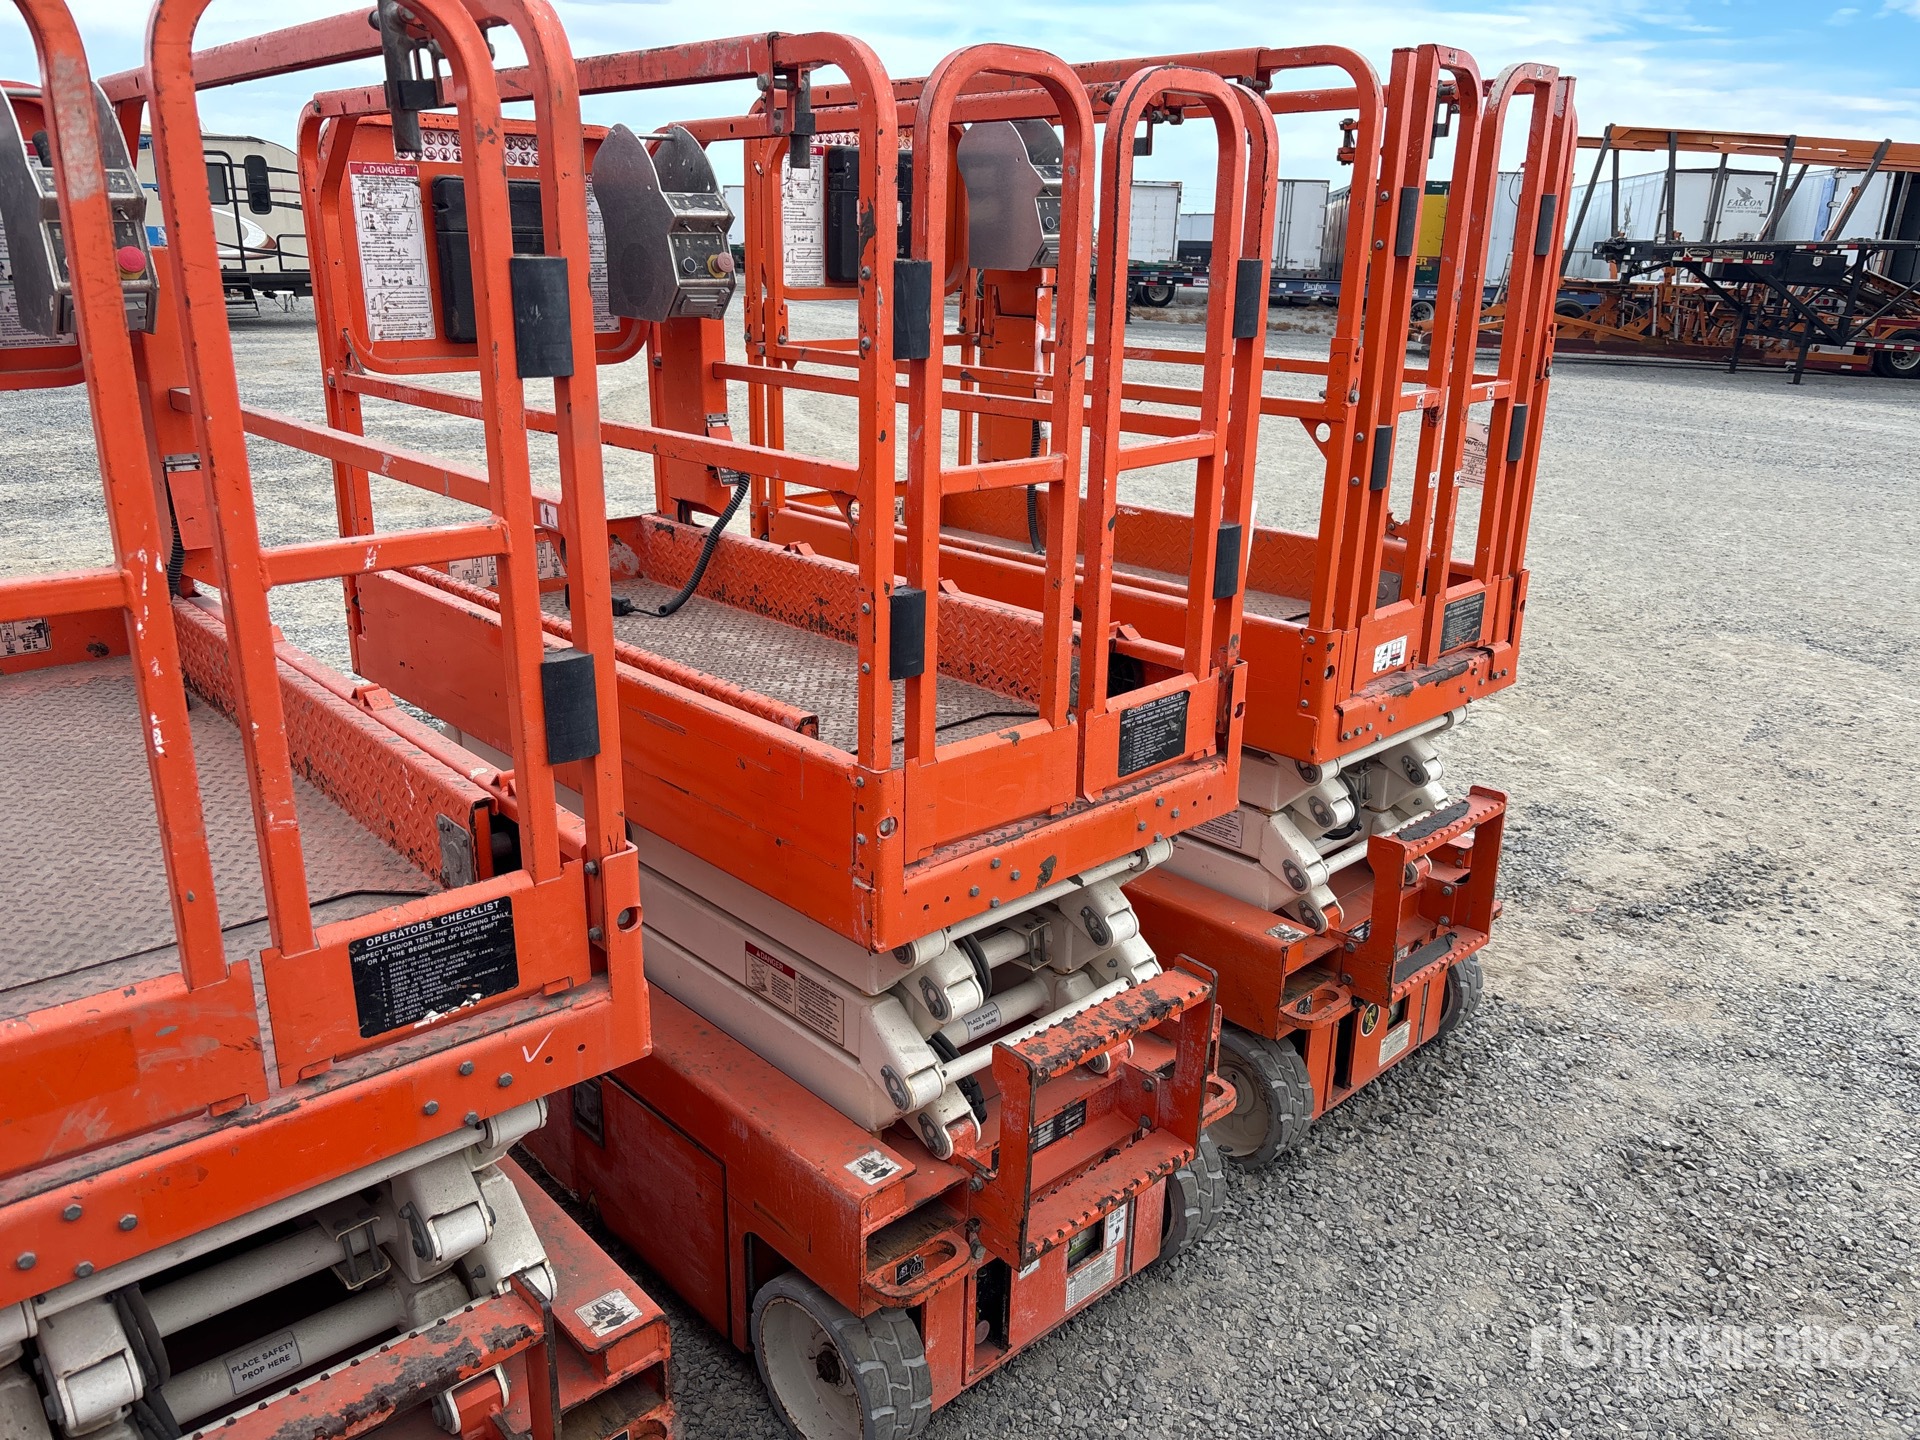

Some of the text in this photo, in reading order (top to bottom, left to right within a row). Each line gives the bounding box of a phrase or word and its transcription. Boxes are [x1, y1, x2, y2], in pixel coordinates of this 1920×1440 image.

[369, 165, 407, 175] DANGER
[1727, 198, 1764, 207] FALCON
[1746, 250, 1775, 260] Mini-5
[366, 901, 500, 947] OPERATORS CHECKLIST
[354, 911, 509, 963] INSPECT AND/OR TEST THE FOLLOWING DAILY
[367, 958, 378, 966] OR
[380, 954, 389, 962] AT
[392, 949, 406, 959] THE
[408, 938, 446, 954] BEGINNING
[460, 928, 478, 938] EACH
[480, 921, 499, 931] SHIFT
[760, 951, 783, 971] DANGER
[967, 1009, 998, 1026] PLACE SAFETY
[973, 1017, 997, 1032] PROP HERE
[232, 1340, 294, 1374] PLACE SAFETY
[242, 1354, 291, 1381] PROP HERE
